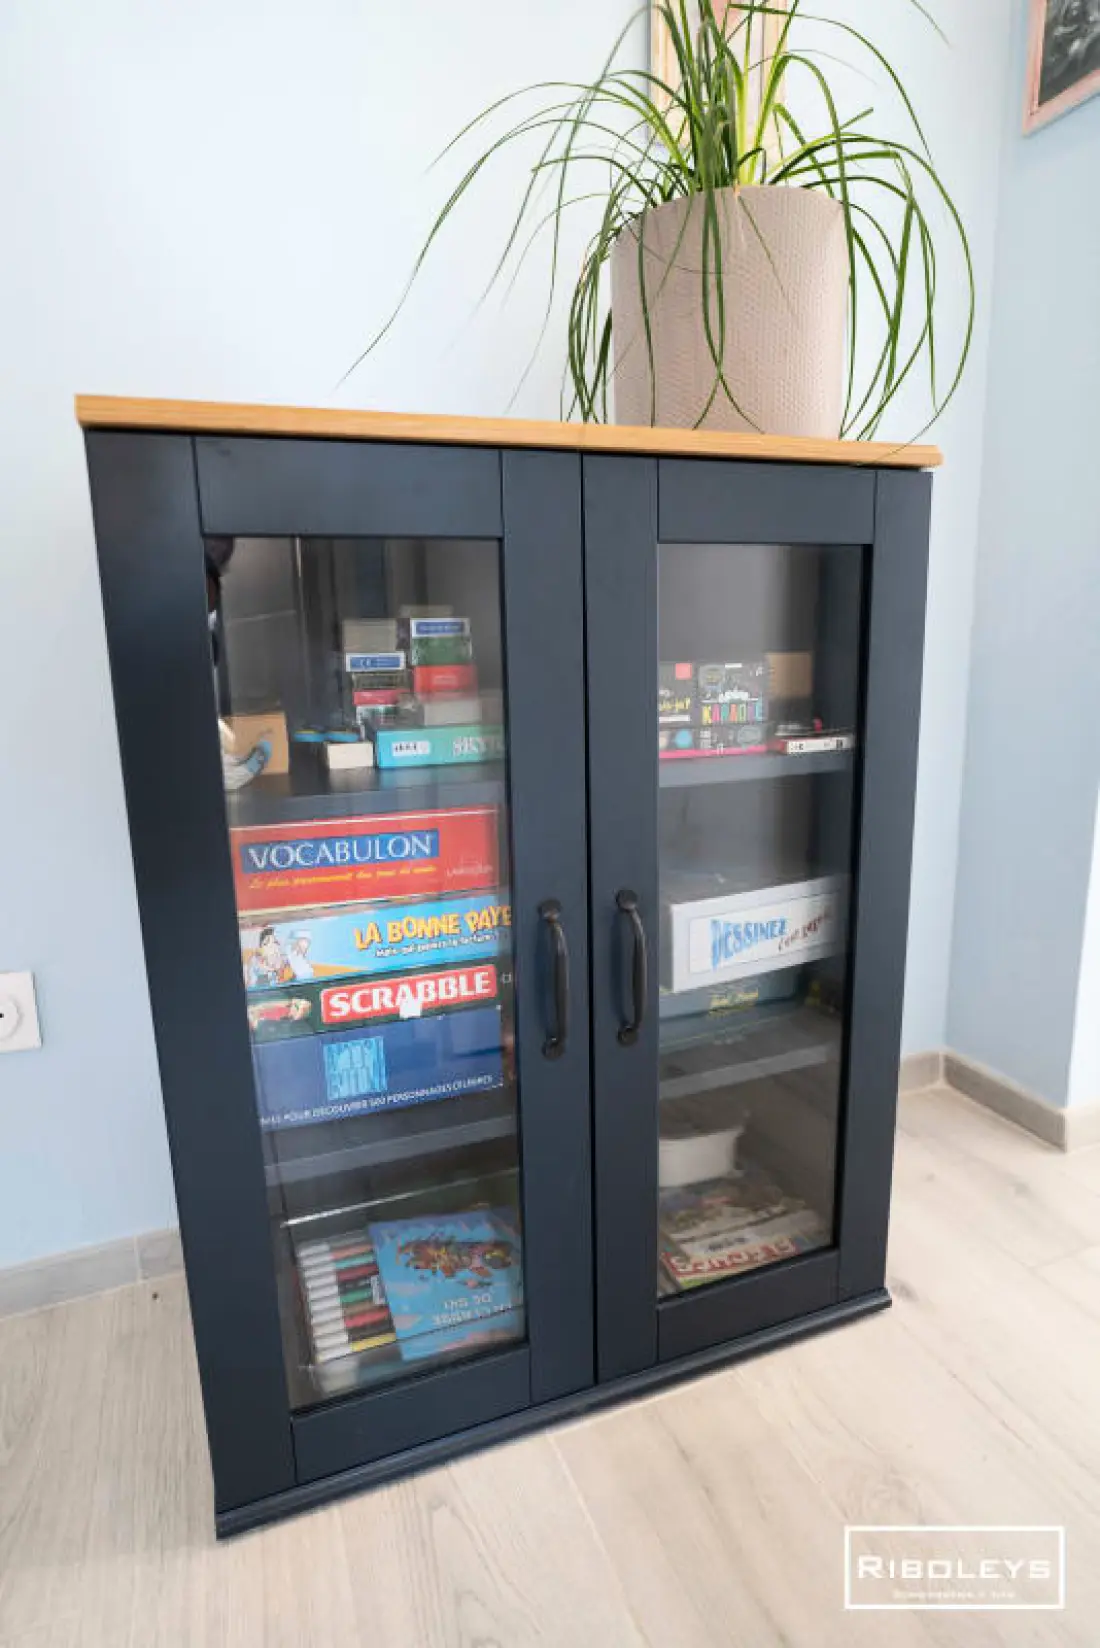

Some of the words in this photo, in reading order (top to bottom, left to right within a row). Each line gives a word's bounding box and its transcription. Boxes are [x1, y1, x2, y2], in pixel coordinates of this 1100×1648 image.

[247, 833, 434, 870] VOCABULON
[353, 921, 382, 950] LA
[386, 913, 462, 943] BONNE
[464, 905, 512, 933] PAYE
[328, 970, 493, 1018] SCRABBLE
